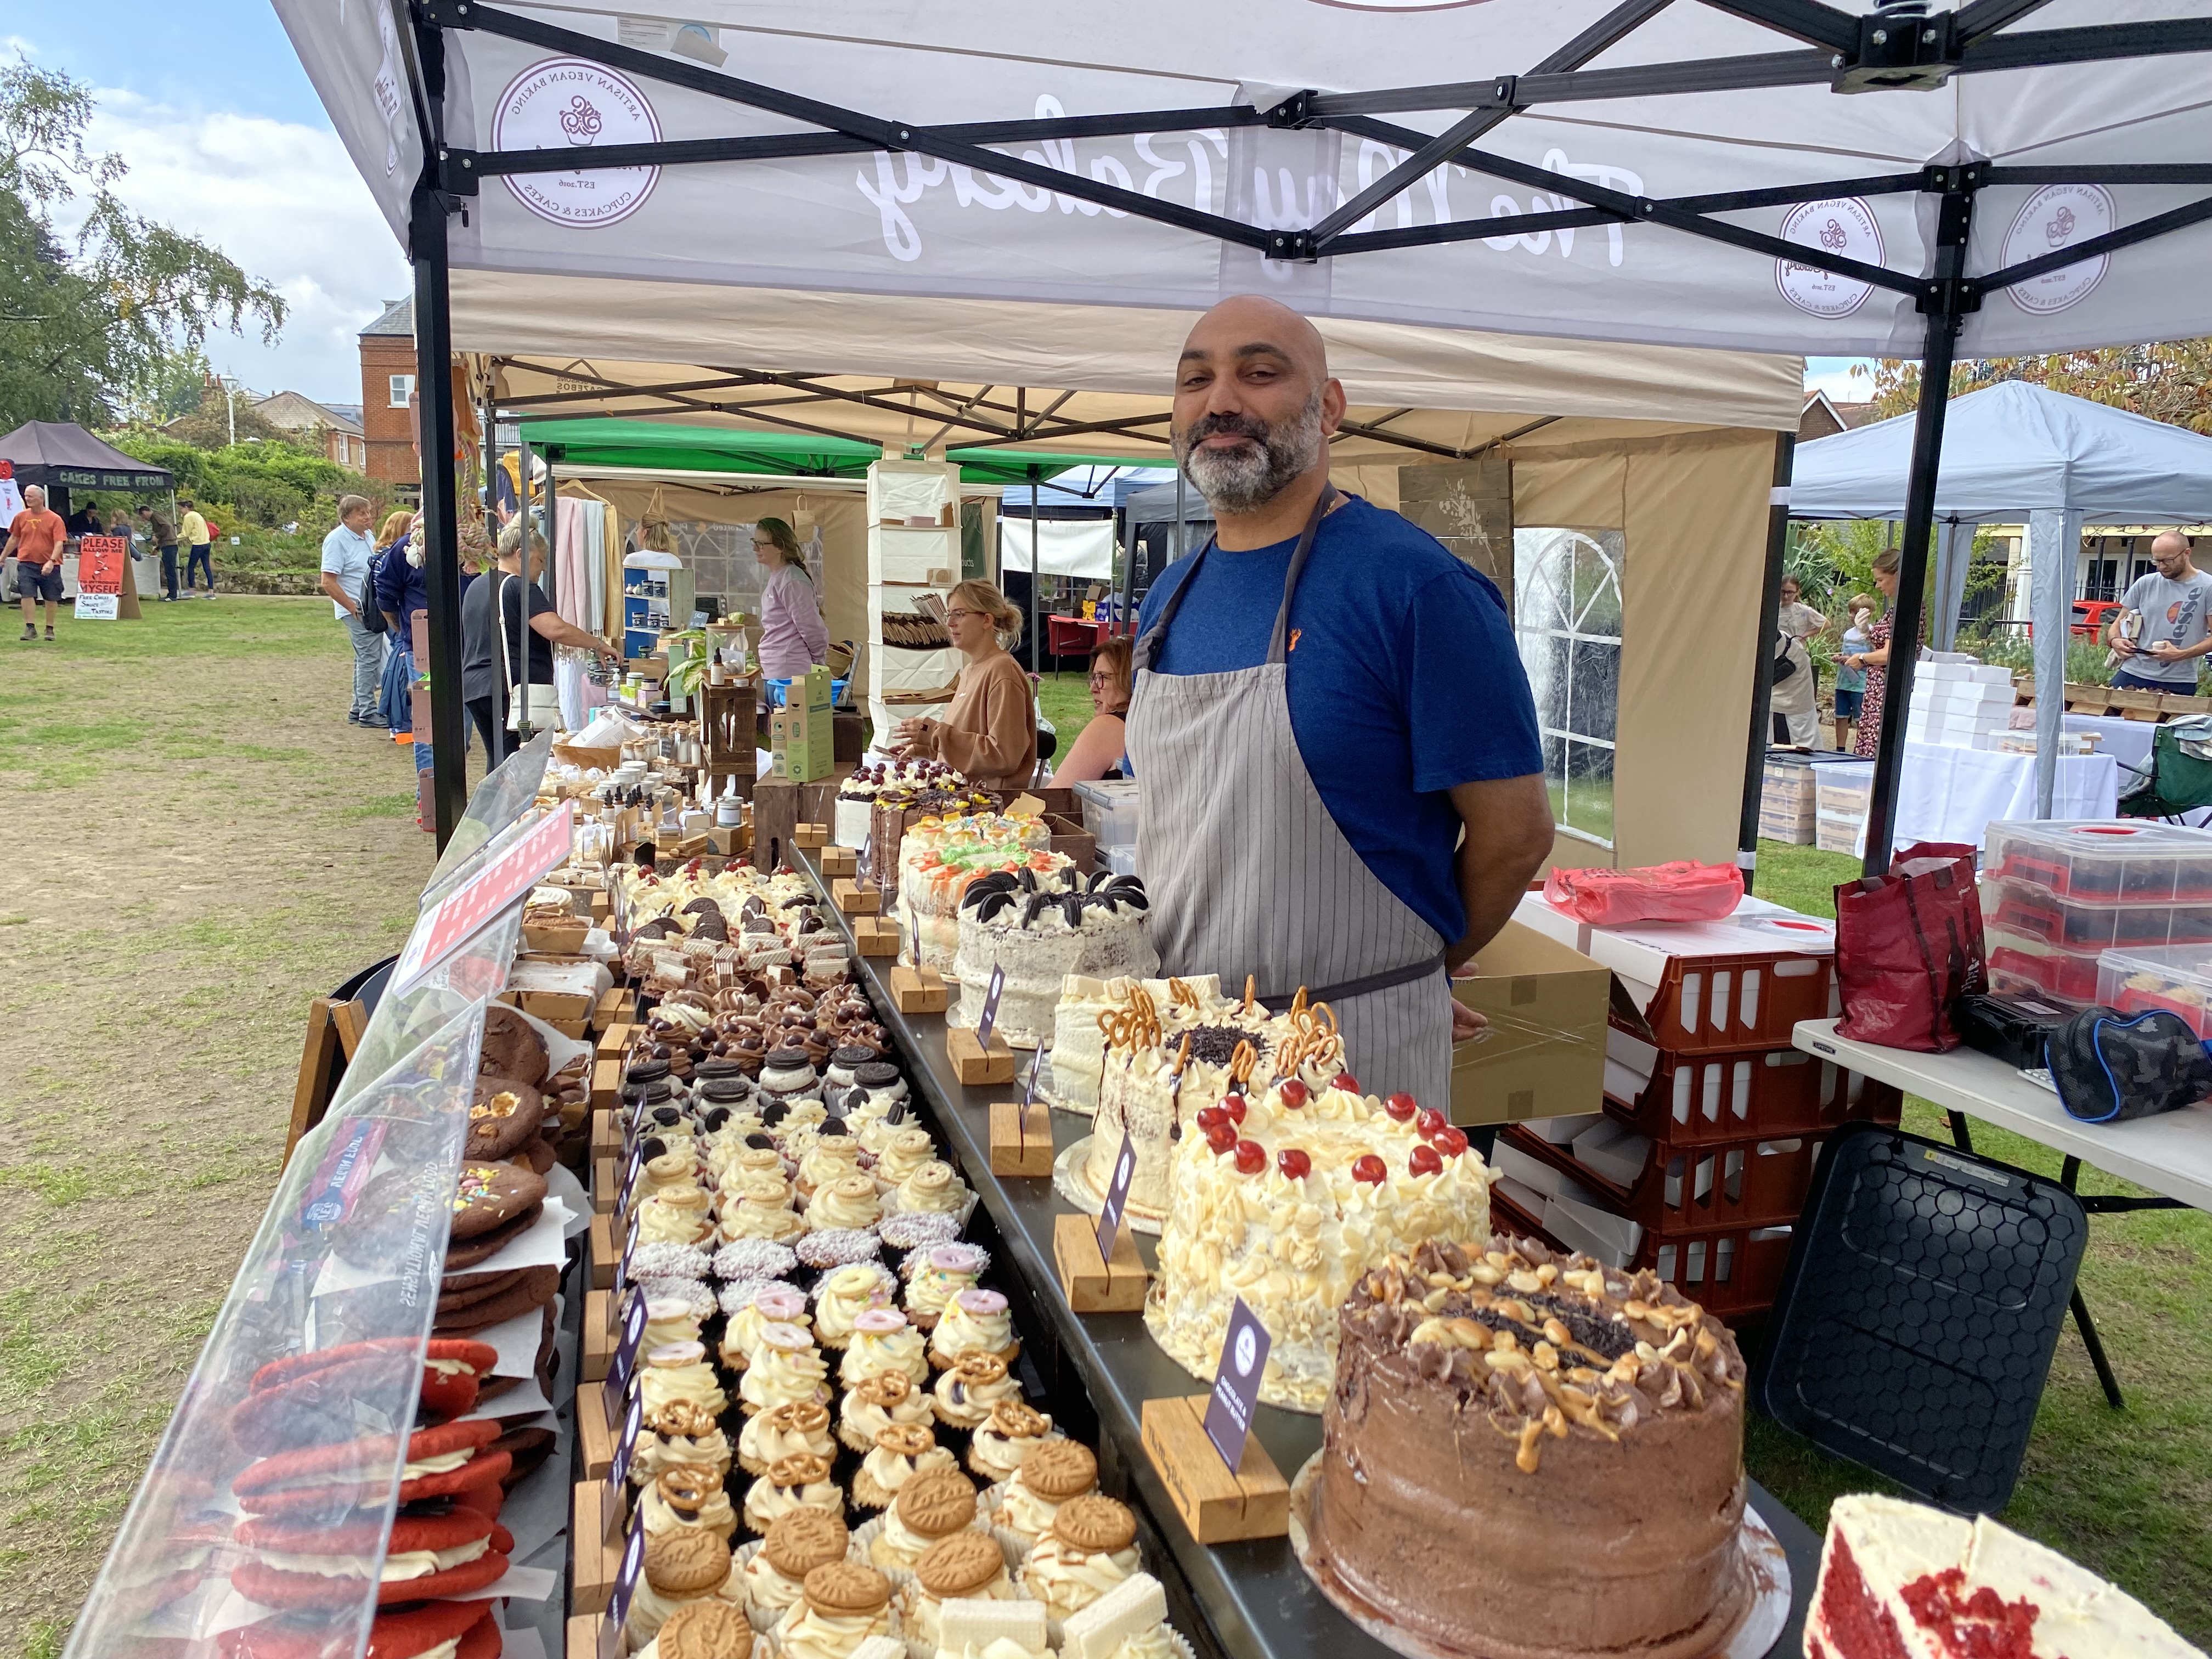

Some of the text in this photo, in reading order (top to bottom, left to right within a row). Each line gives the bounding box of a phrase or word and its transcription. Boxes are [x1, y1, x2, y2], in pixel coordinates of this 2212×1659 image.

[60, 472, 165, 486] CAKES FREE FROM
[83, 538, 123, 548] PLEASE
[81, 584, 119, 593] MYSELF
[1221, 1374, 1244, 1412] CHOCOLATE
[1216, 1383, 1231, 1411] PEANUT
[1229, 1405, 1246, 1433] BUTTER
